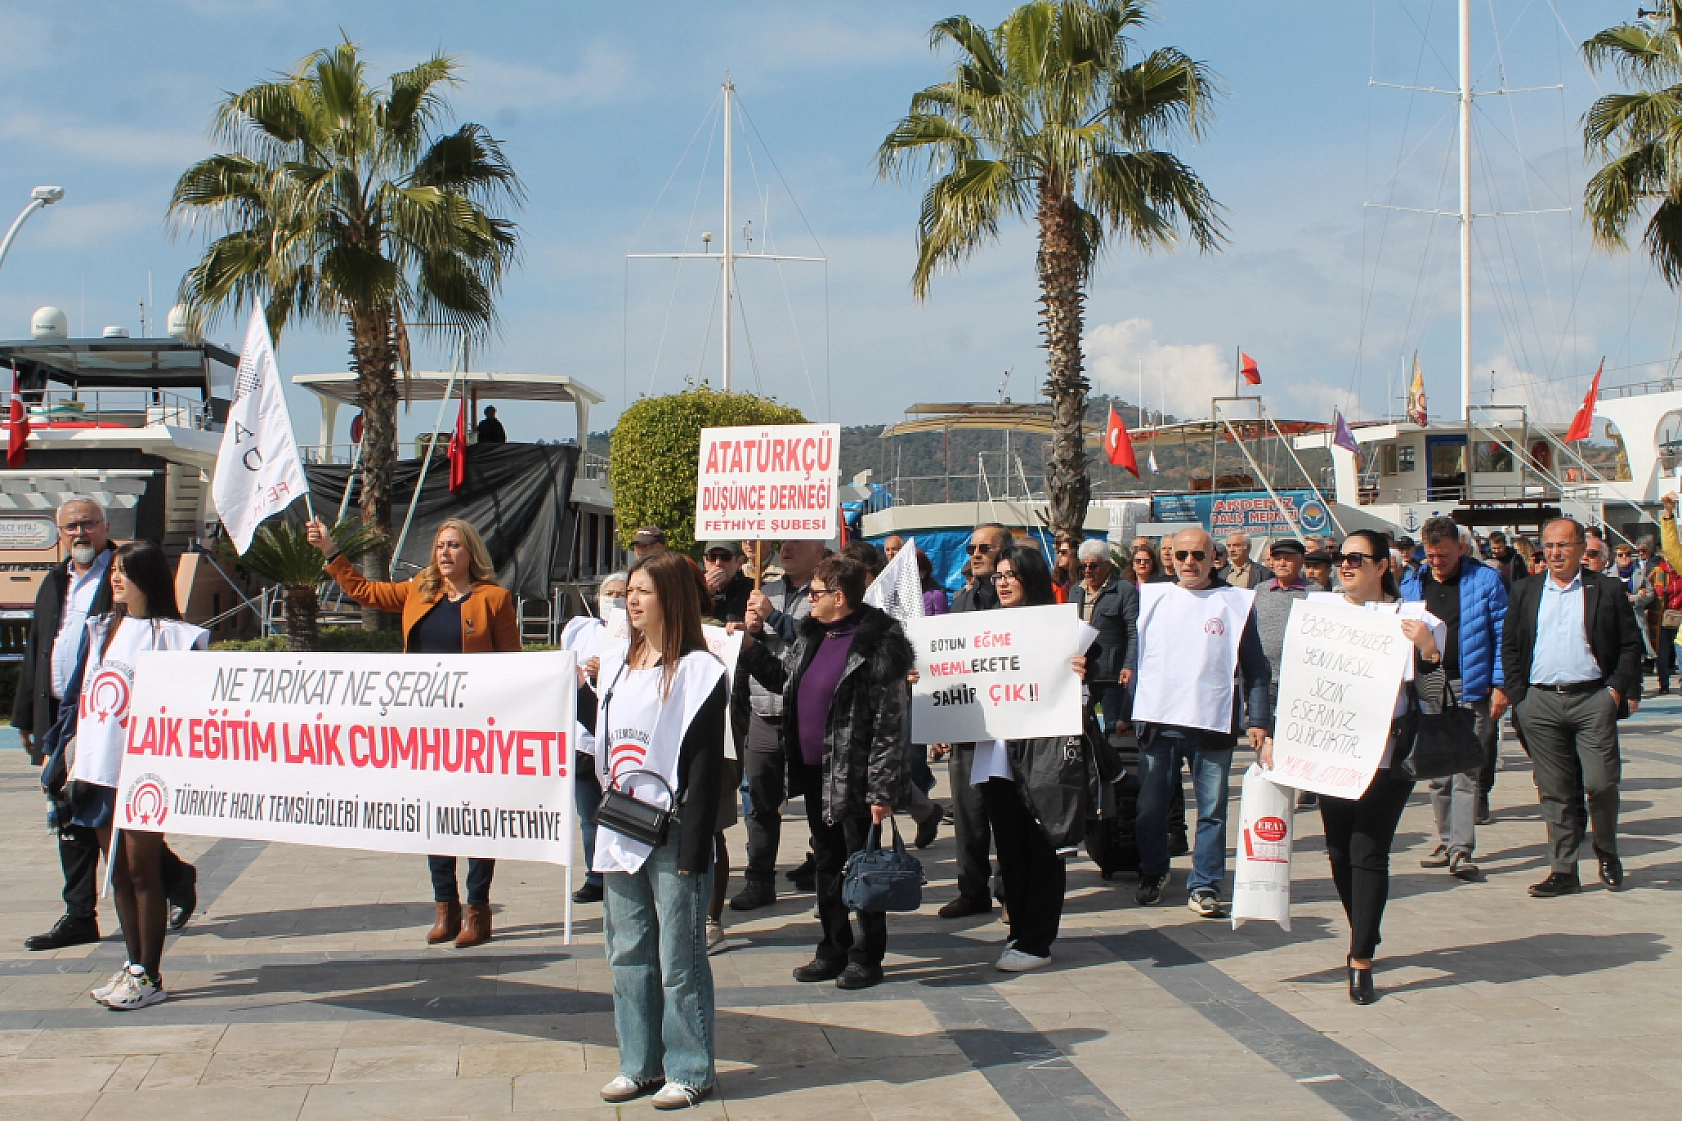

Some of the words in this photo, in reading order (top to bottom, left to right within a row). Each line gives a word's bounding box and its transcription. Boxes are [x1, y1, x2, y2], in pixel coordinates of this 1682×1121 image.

[706, 430, 832, 480] ATATÜRKÇÜ
[703, 481, 766, 517] DÜŞÜNCE
[770, 477, 831, 510] DERNEĞİ
[704, 517, 766, 531] FETHİYE
[771, 516, 827, 533] ŞUBESİ
[974, 631, 1012, 648] EĞME
[929, 655, 1021, 677] MEMLEKETE
[211, 667, 248, 701] NE
[249, 660, 344, 705] TARİKAT
[342, 671, 381, 706] NE
[379, 661, 468, 716] ŞERİAT:
[932, 683, 977, 706] SAHİP
[127, 706, 183, 757] LAİK
[188, 708, 277, 763] EĞİTİM
[282, 712, 345, 766] LAİK
[349, 716, 567, 777] CUMHURİYET!
[174, 783, 228, 818] TÜRKİYE
[229, 791, 266, 821] HALK
[269, 791, 359, 828] TEMSİLCİLERİ
[363, 797, 421, 833] MECLİSİ
[436, 800, 562, 842] MUĞLA/FETHİYE
